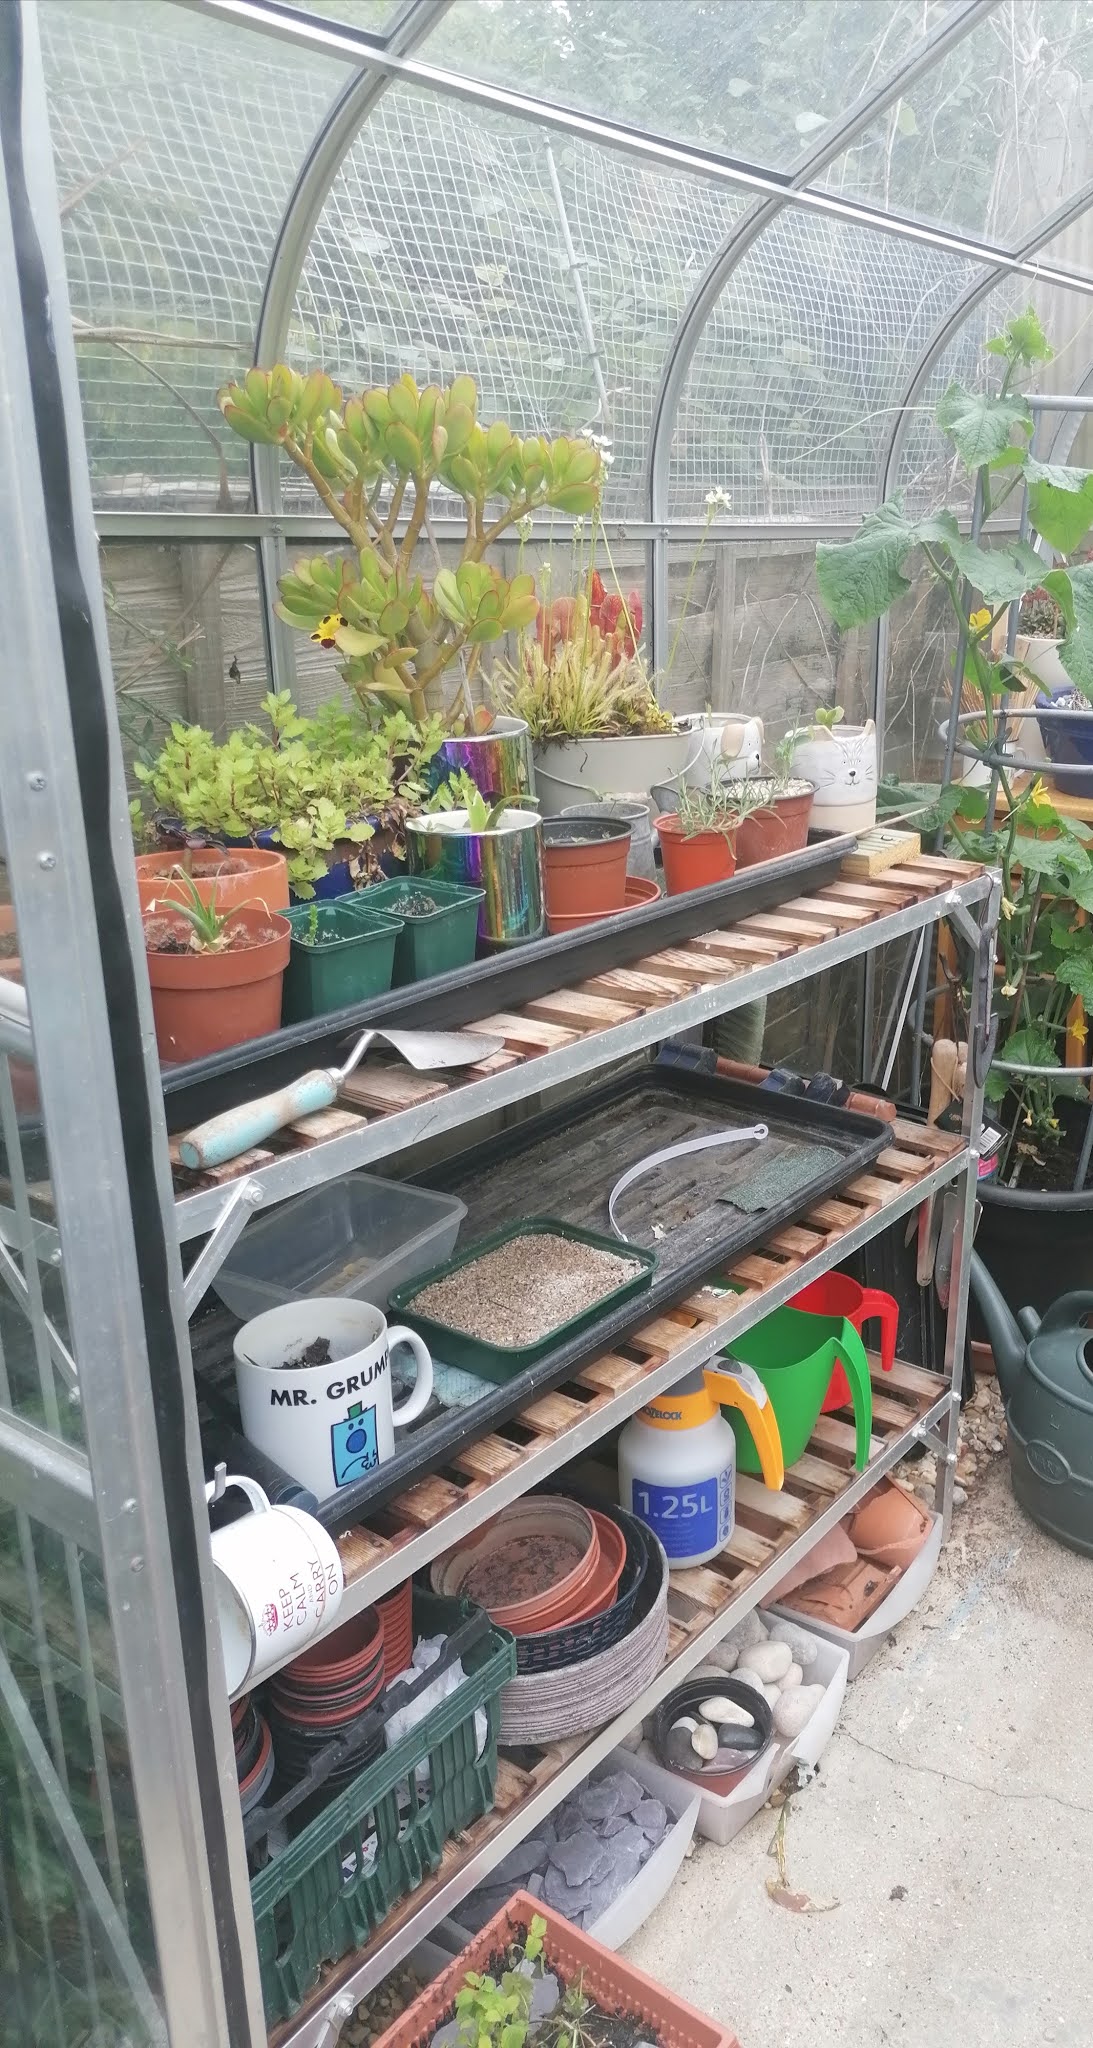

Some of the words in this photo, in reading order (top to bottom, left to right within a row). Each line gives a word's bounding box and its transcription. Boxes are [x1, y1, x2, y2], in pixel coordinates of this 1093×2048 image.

[270, 1389, 317, 1406] MR.
[641, 1405, 682, 1420] OZELOCK
[637, 1491, 713, 1519] 1.25L
[307, 1560, 326, 1618] CARRY
[324, 1563, 339, 1596] ON
[278, 1588, 294, 1632] KEEP
[290, 1572, 307, 1626] CALM
